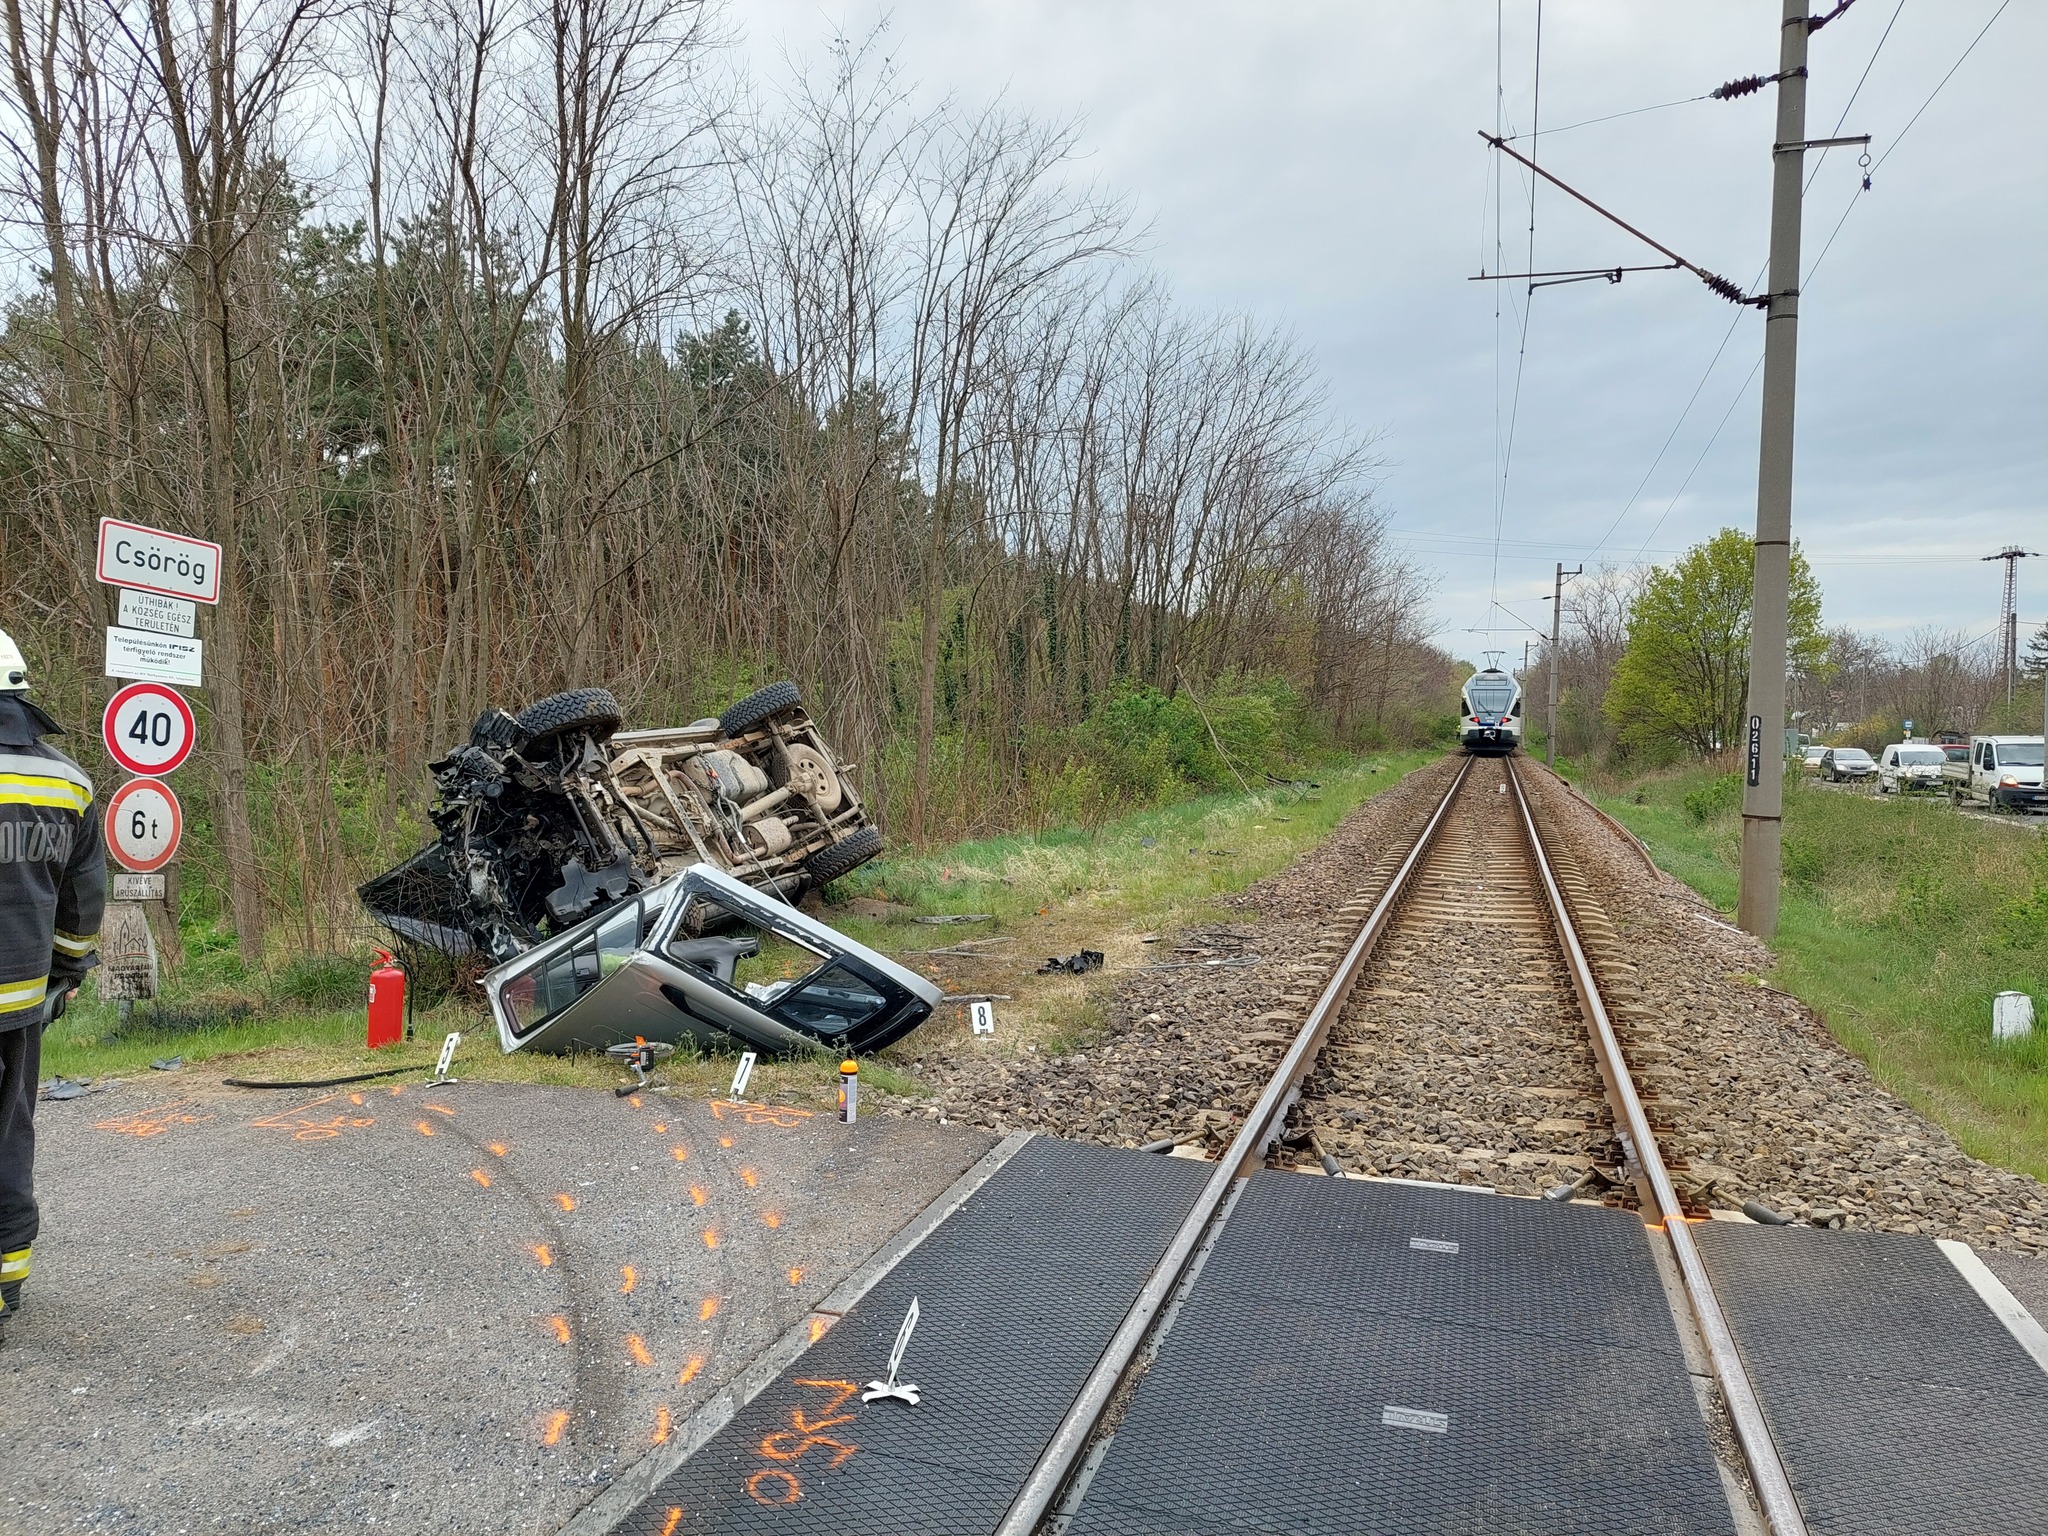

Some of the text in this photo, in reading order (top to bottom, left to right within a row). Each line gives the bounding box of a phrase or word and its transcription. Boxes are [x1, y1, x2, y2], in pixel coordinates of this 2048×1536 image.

[116, 541, 205, 585] Csörög
[138, 593, 174, 610] ÚTHIBÁK
[123, 604, 192, 625] A KÖZSÉG EGÉSZ
[135, 616, 180, 633] TERÜLETÉN
[157, 650, 187, 660] rendszer
[129, 710, 172, 746] 40
[978, 1006, 987, 1026] 8
